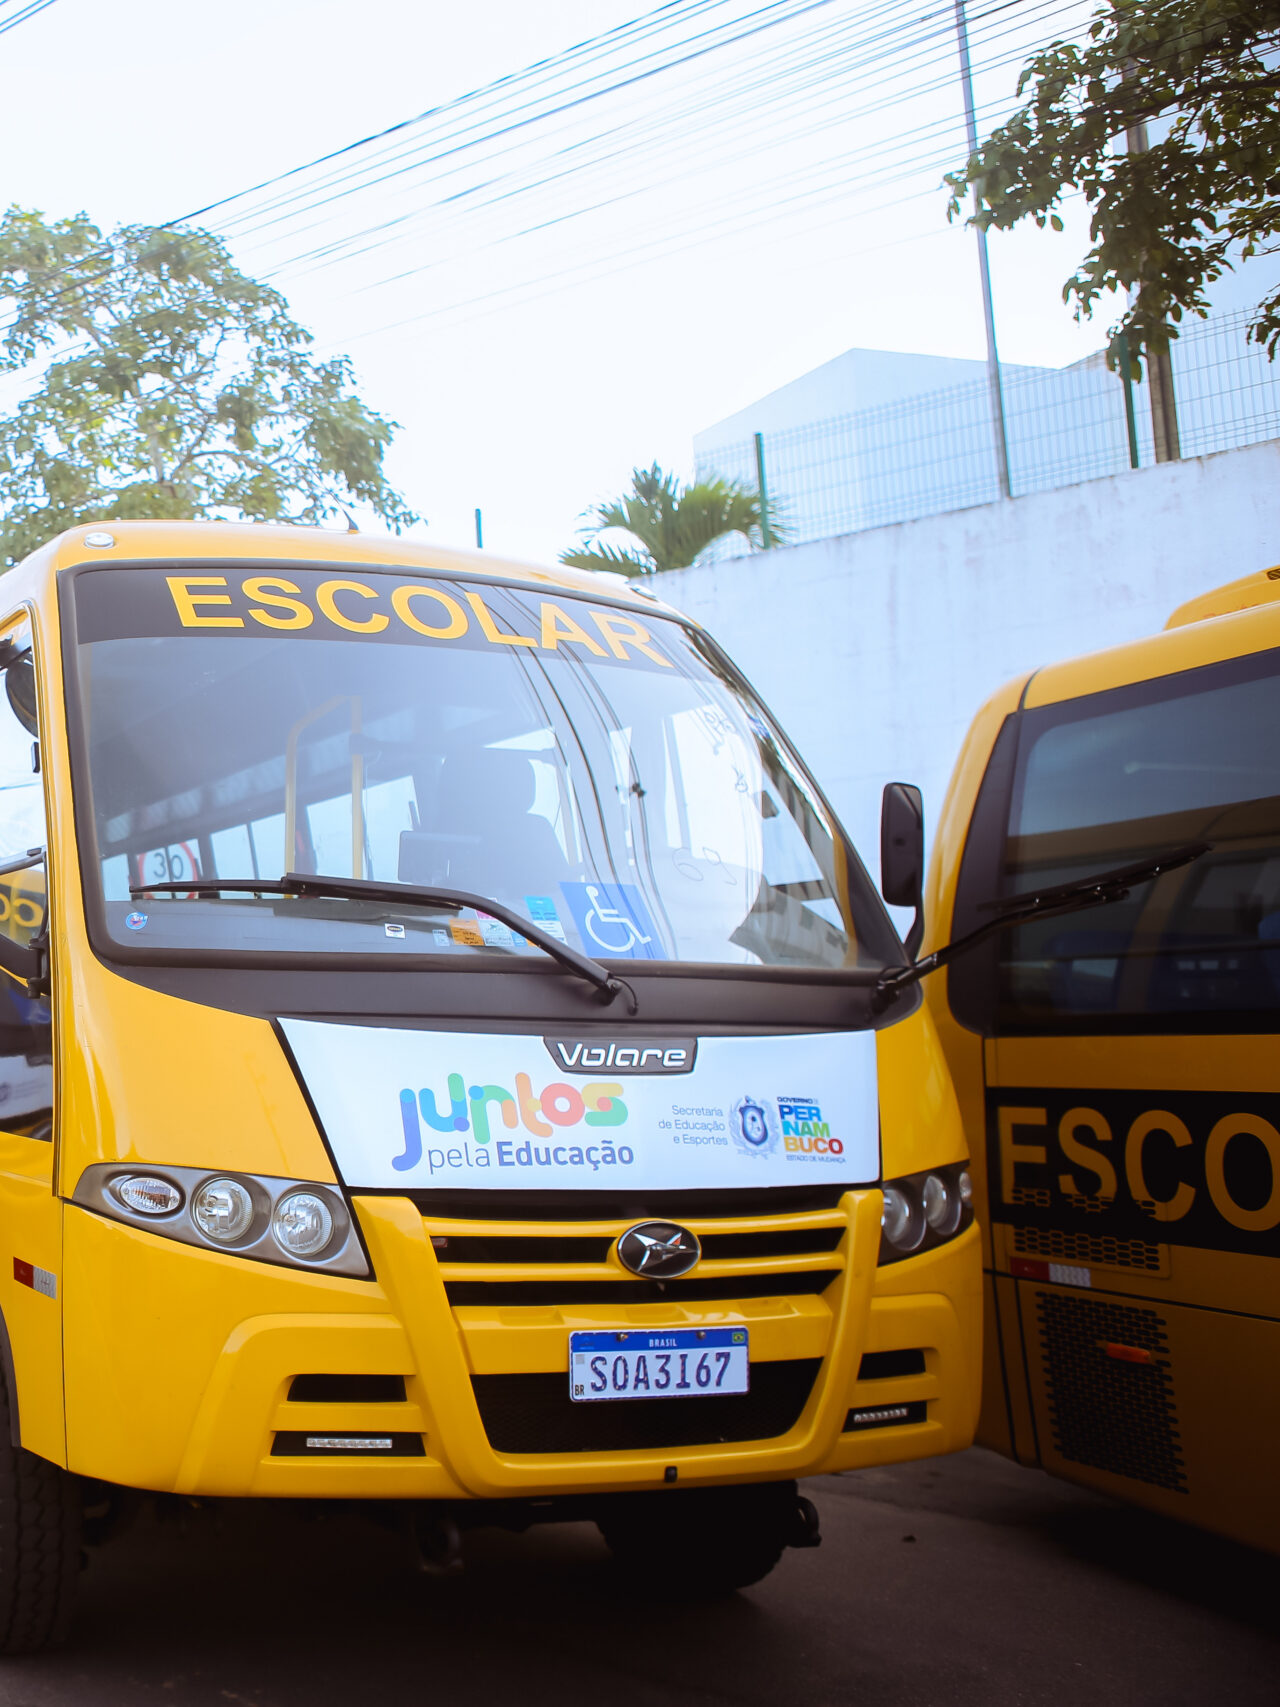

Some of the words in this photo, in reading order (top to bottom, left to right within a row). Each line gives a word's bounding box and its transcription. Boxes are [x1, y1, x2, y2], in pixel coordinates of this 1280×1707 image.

[165, 576, 674, 668] ESCOLAR
[557, 1043, 687, 1067] Volare
[672, 1104, 723, 1117] Secretaria
[778, 1104, 822, 1122] PER
[391, 1072, 628, 1171] juntos
[658, 1119, 672, 1130] de
[675, 1119, 725, 1133] Educação
[782, 1120, 830, 1138] NAM
[673, 1135, 680, 1144] e
[682, 1133, 728, 1147] Esportes
[784, 1136, 843, 1155] BUCO
[428, 1142, 490, 1175] pela
[496, 1140, 634, 1171] Educação
[649, 1338, 677, 1348] BRASIL
[590, 1351, 731, 1392] SOA3I67
[575, 1384, 585, 1396] BR
